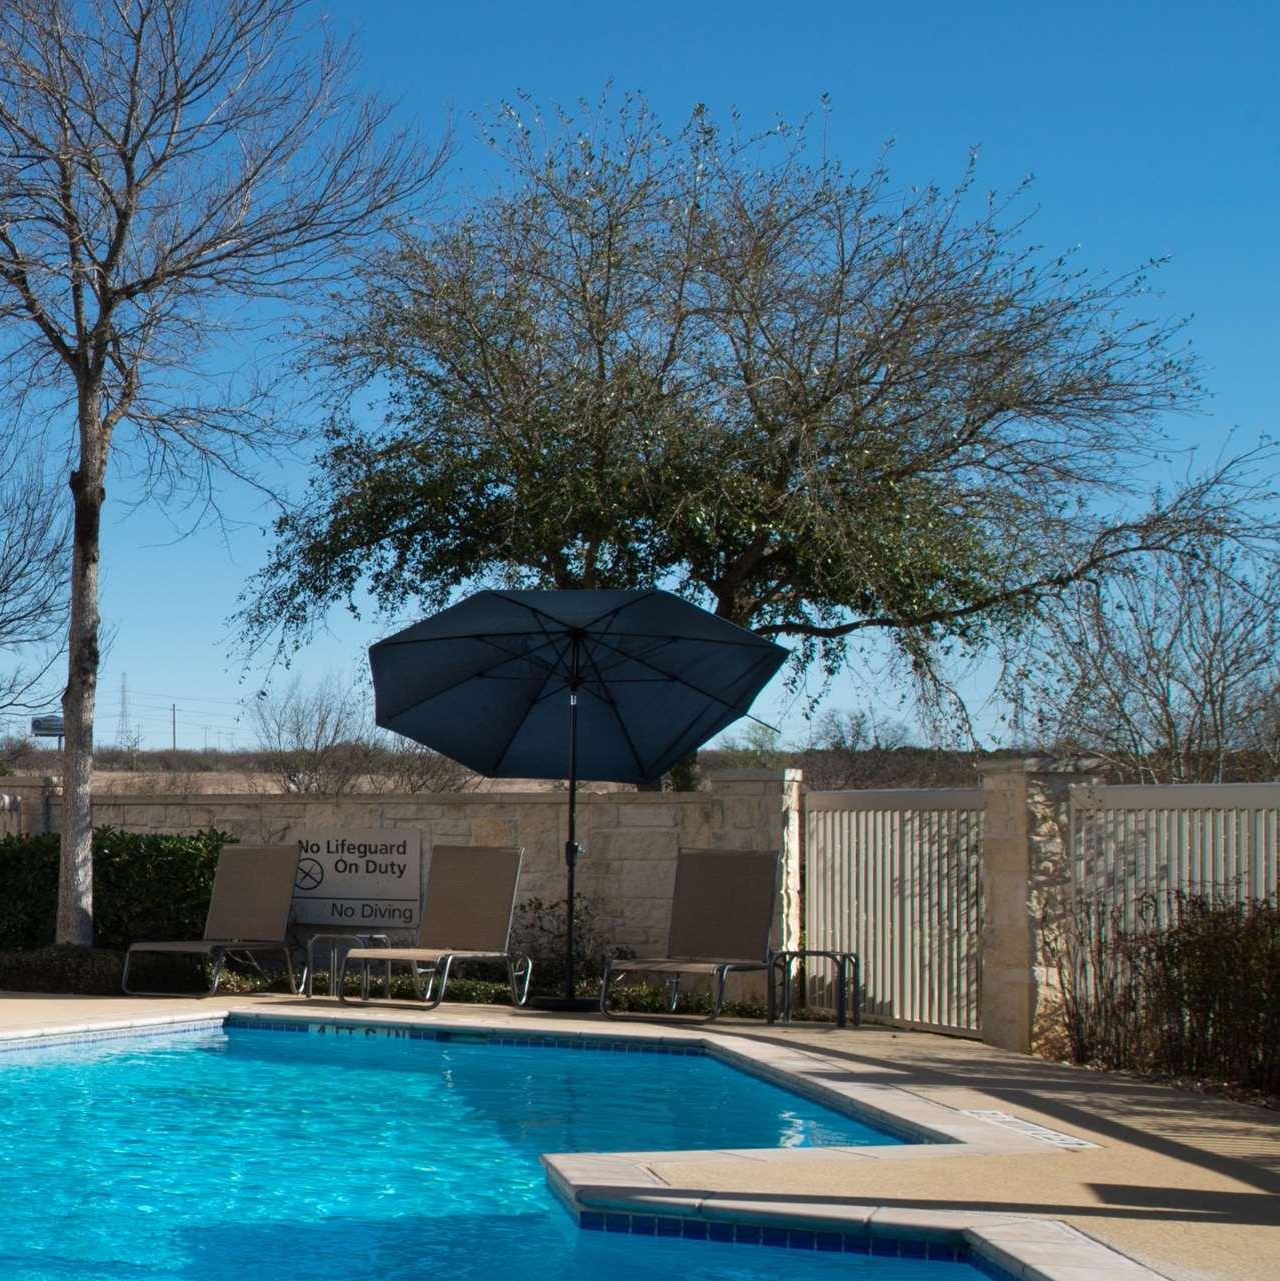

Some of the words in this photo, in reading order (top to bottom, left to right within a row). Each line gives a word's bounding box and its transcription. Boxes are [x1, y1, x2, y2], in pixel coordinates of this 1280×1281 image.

[298, 839, 320, 854] No
[326, 839, 407, 858] Lifeguard
[334, 859, 358, 874] On
[365, 860, 407, 878] Duty
[331, 903, 355, 918] No
[361, 903, 413, 923] Diving
